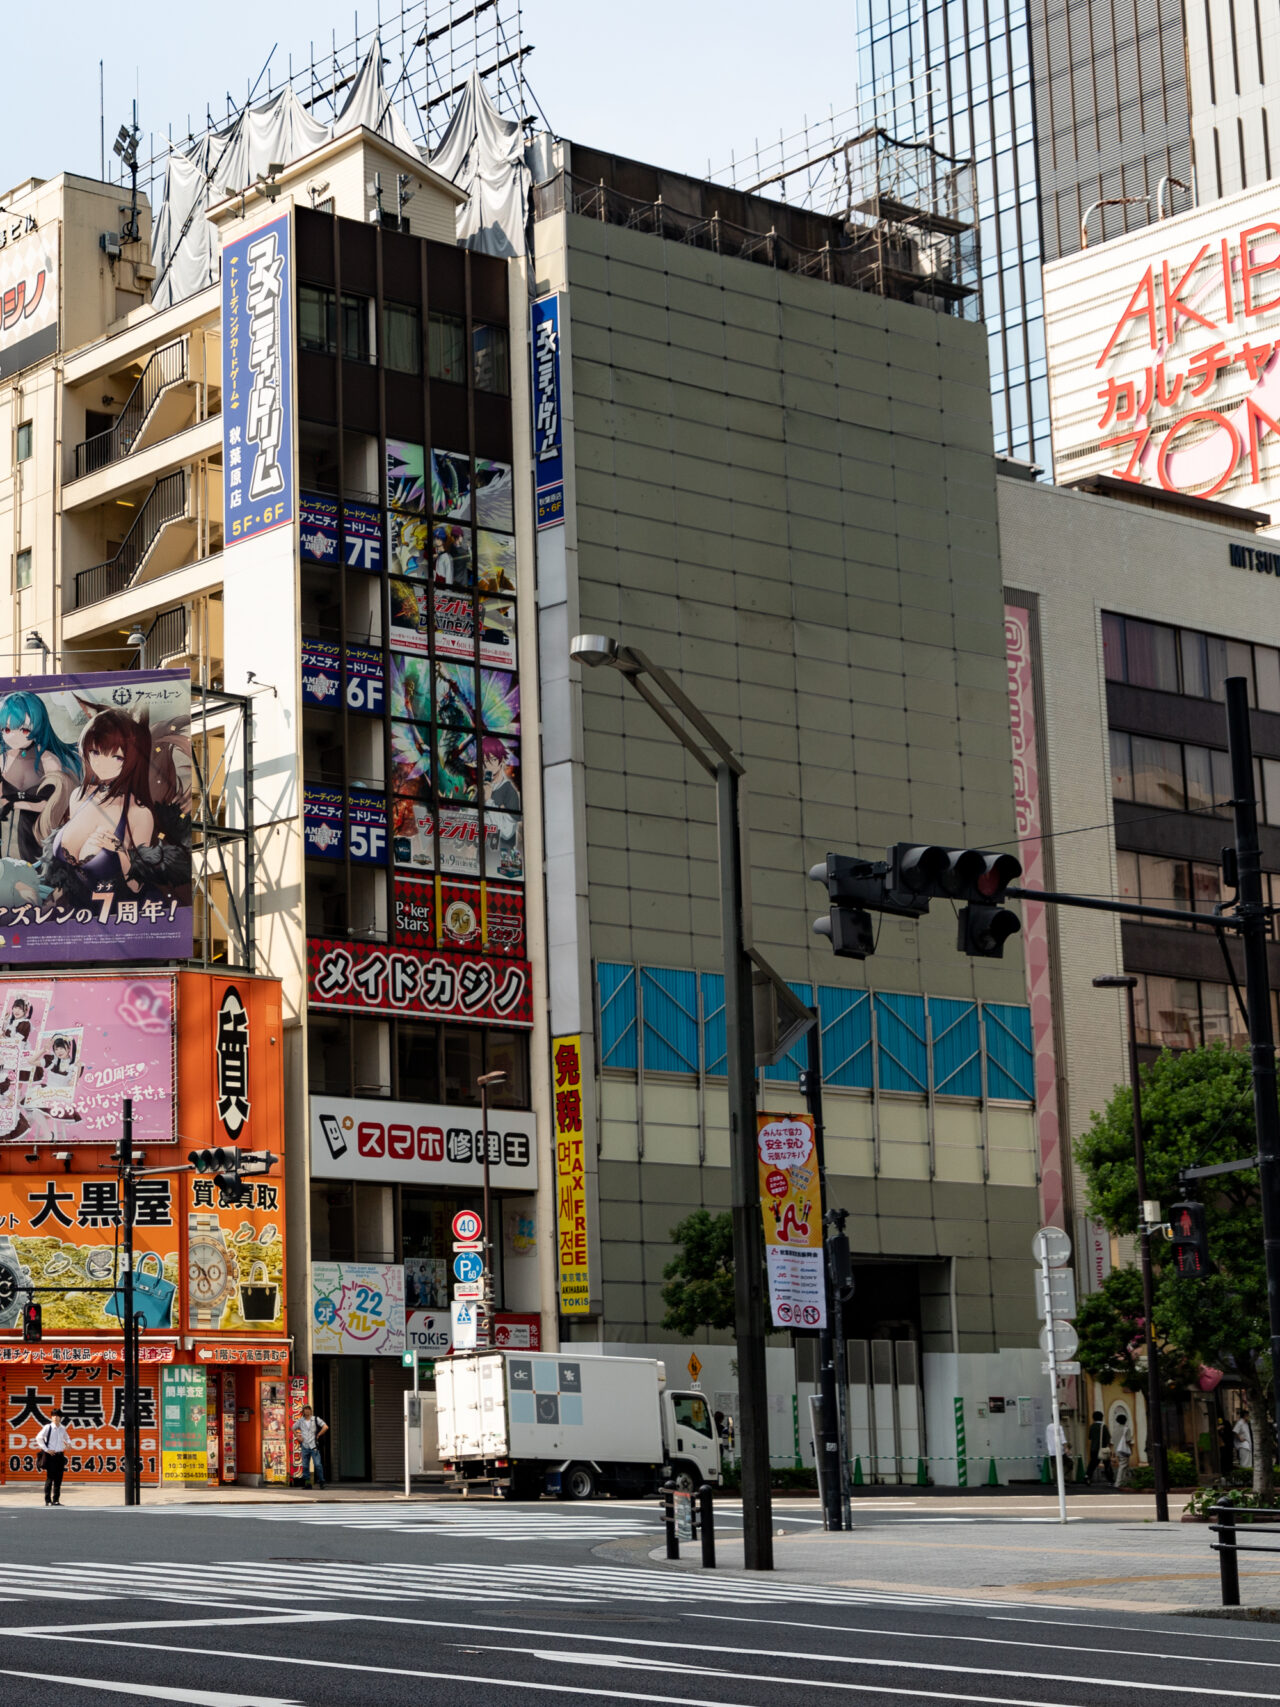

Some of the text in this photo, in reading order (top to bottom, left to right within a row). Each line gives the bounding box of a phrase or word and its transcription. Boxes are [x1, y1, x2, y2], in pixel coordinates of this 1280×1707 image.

[1098, 338, 1280, 430] カルチャ
[229, 426, 242, 510] 秋葉原店
[345, 535, 380, 569] 7F
[135, 688, 183, 703] アズールレーン
[346, 677, 383, 710] 6F
[349, 825, 386, 858] 5F
[396, 915, 430, 932] Stars
[315, 949, 525, 1016] メイドカジノ
[554, 1043, 583, 1134] 免税
[357, 1121, 531, 1168] スマホ修理王
[765, 1138, 804, 1151] 安全・安心
[28, 1180, 173, 1229] 大黒屋
[571, 1140, 587, 1266] TAX FREE
[459, 1219, 475, 1233] 40
[460, 1260, 472, 1280] P
[356, 1288, 383, 1317] 22
[561, 1284, 588, 1295] AKIHABARA
[317, 1306, 333, 1321] 2F
[165, 1385, 204, 1398] 簡単査定
[292, 1378, 305, 1389] 4F
[7, 1385, 157, 1430] 大黒屋
